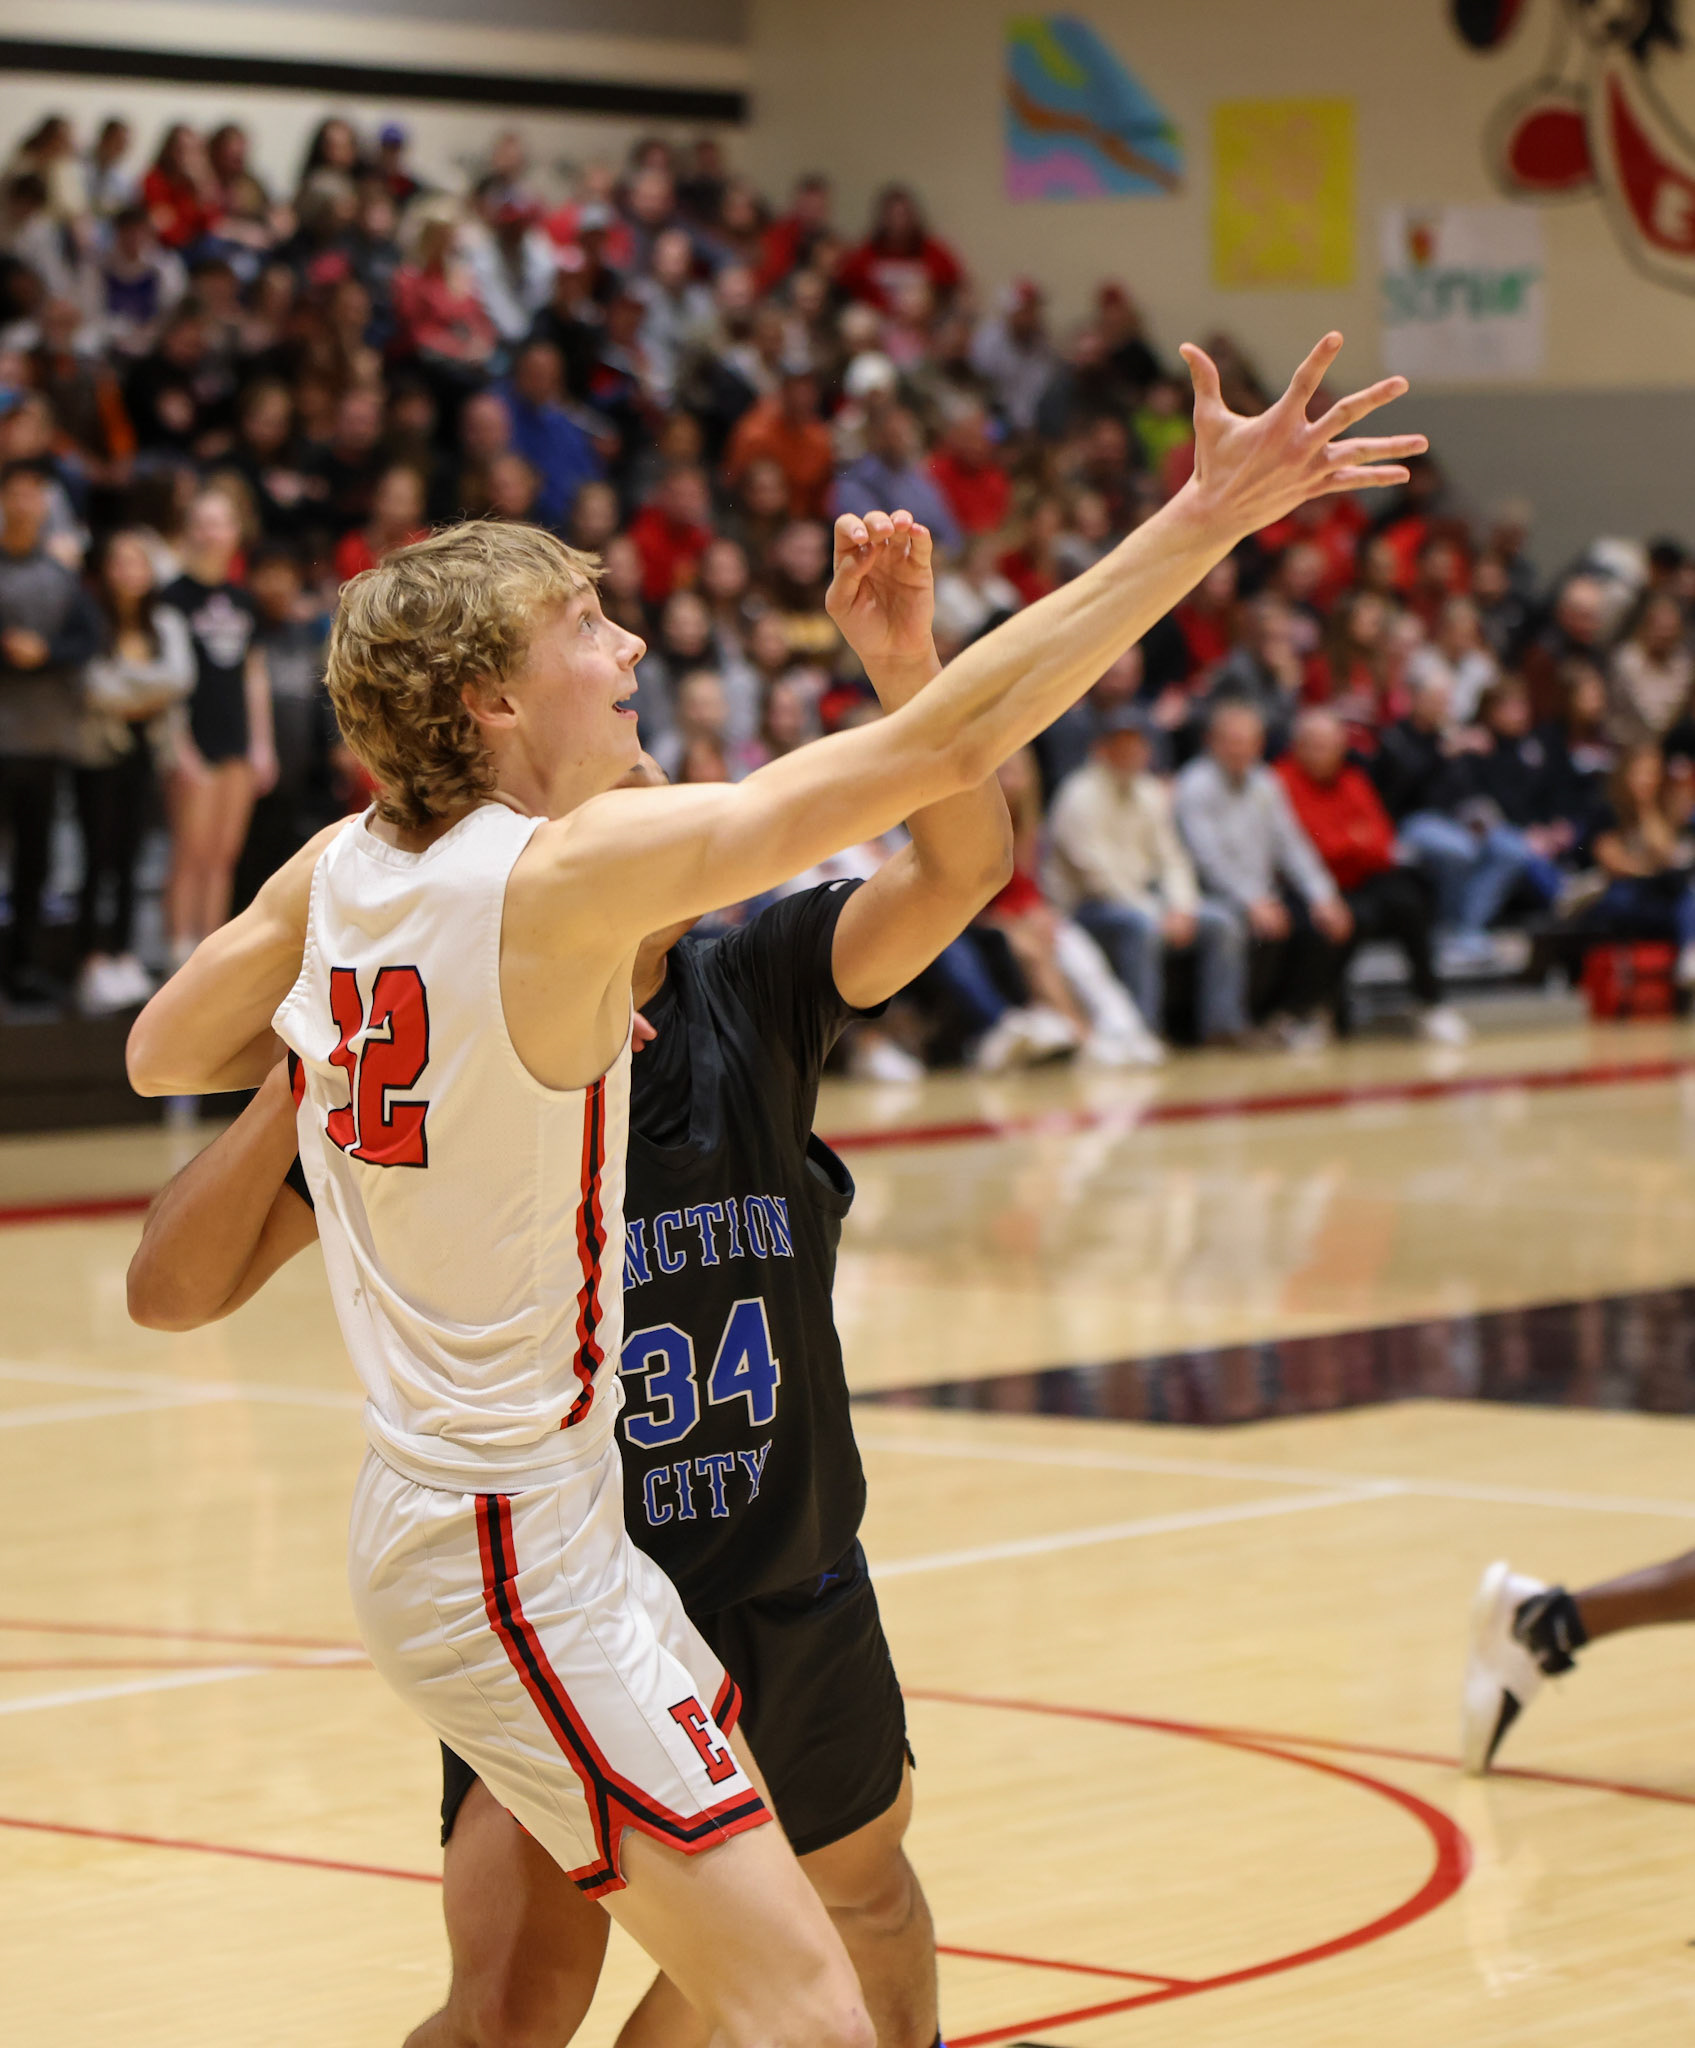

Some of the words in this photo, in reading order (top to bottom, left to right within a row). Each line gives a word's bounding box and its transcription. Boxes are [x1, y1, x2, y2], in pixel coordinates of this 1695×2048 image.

[618, 1296, 780, 1449] 34
[643, 1439, 772, 1525] CITY
[667, 1695, 737, 1785] E
